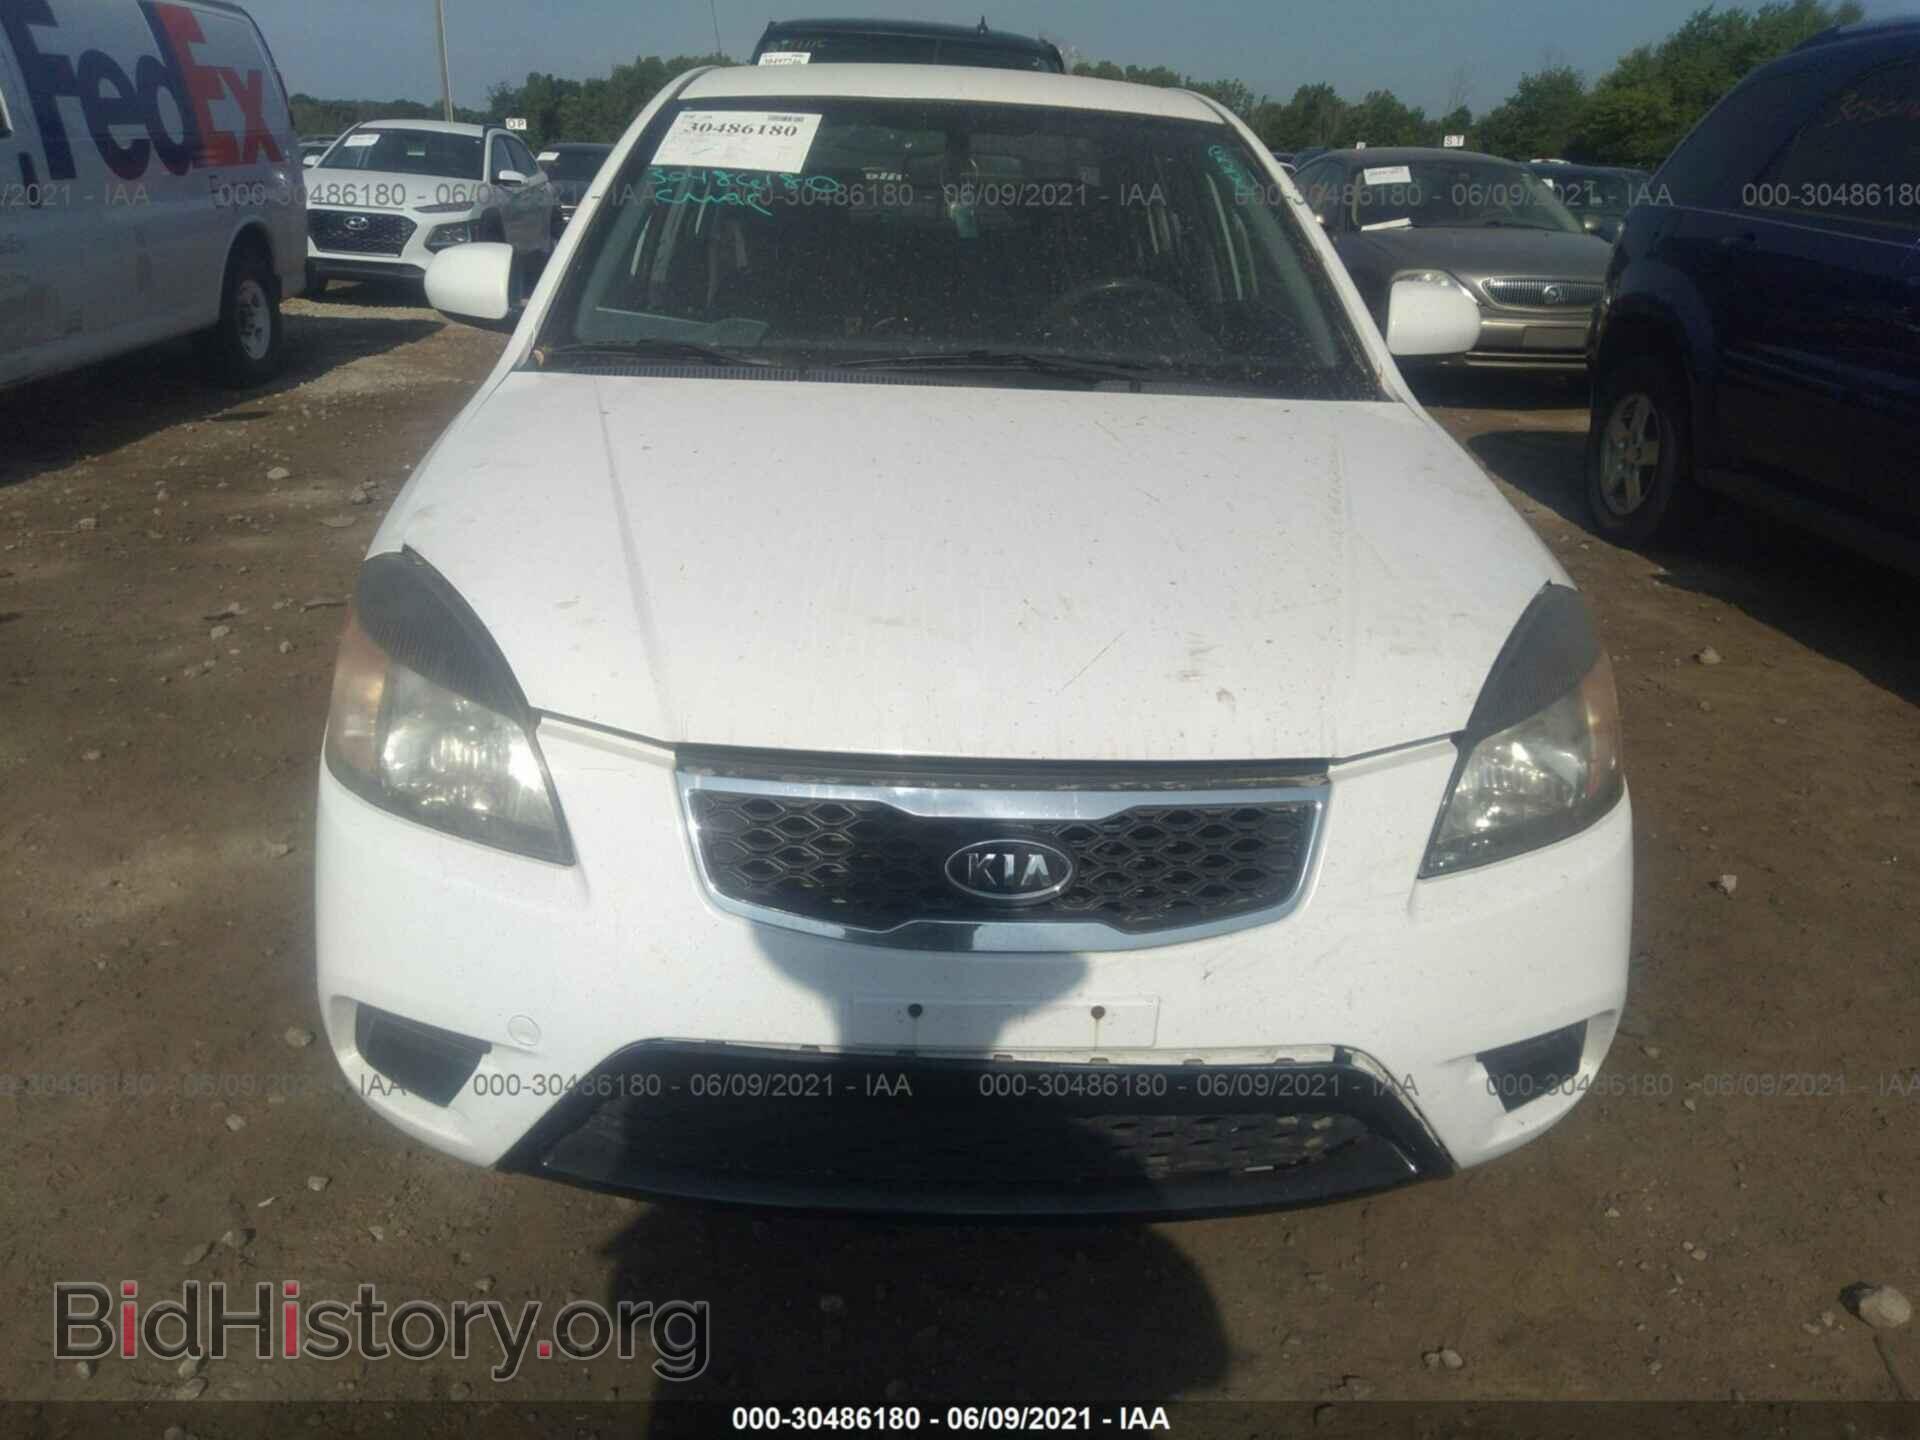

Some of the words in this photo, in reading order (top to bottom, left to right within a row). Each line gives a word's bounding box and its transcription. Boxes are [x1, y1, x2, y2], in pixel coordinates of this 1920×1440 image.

[0, 0, 285, 180] FedEx
[682, 122, 798, 137] 30486180
[967, 852, 1050, 886] KIA
